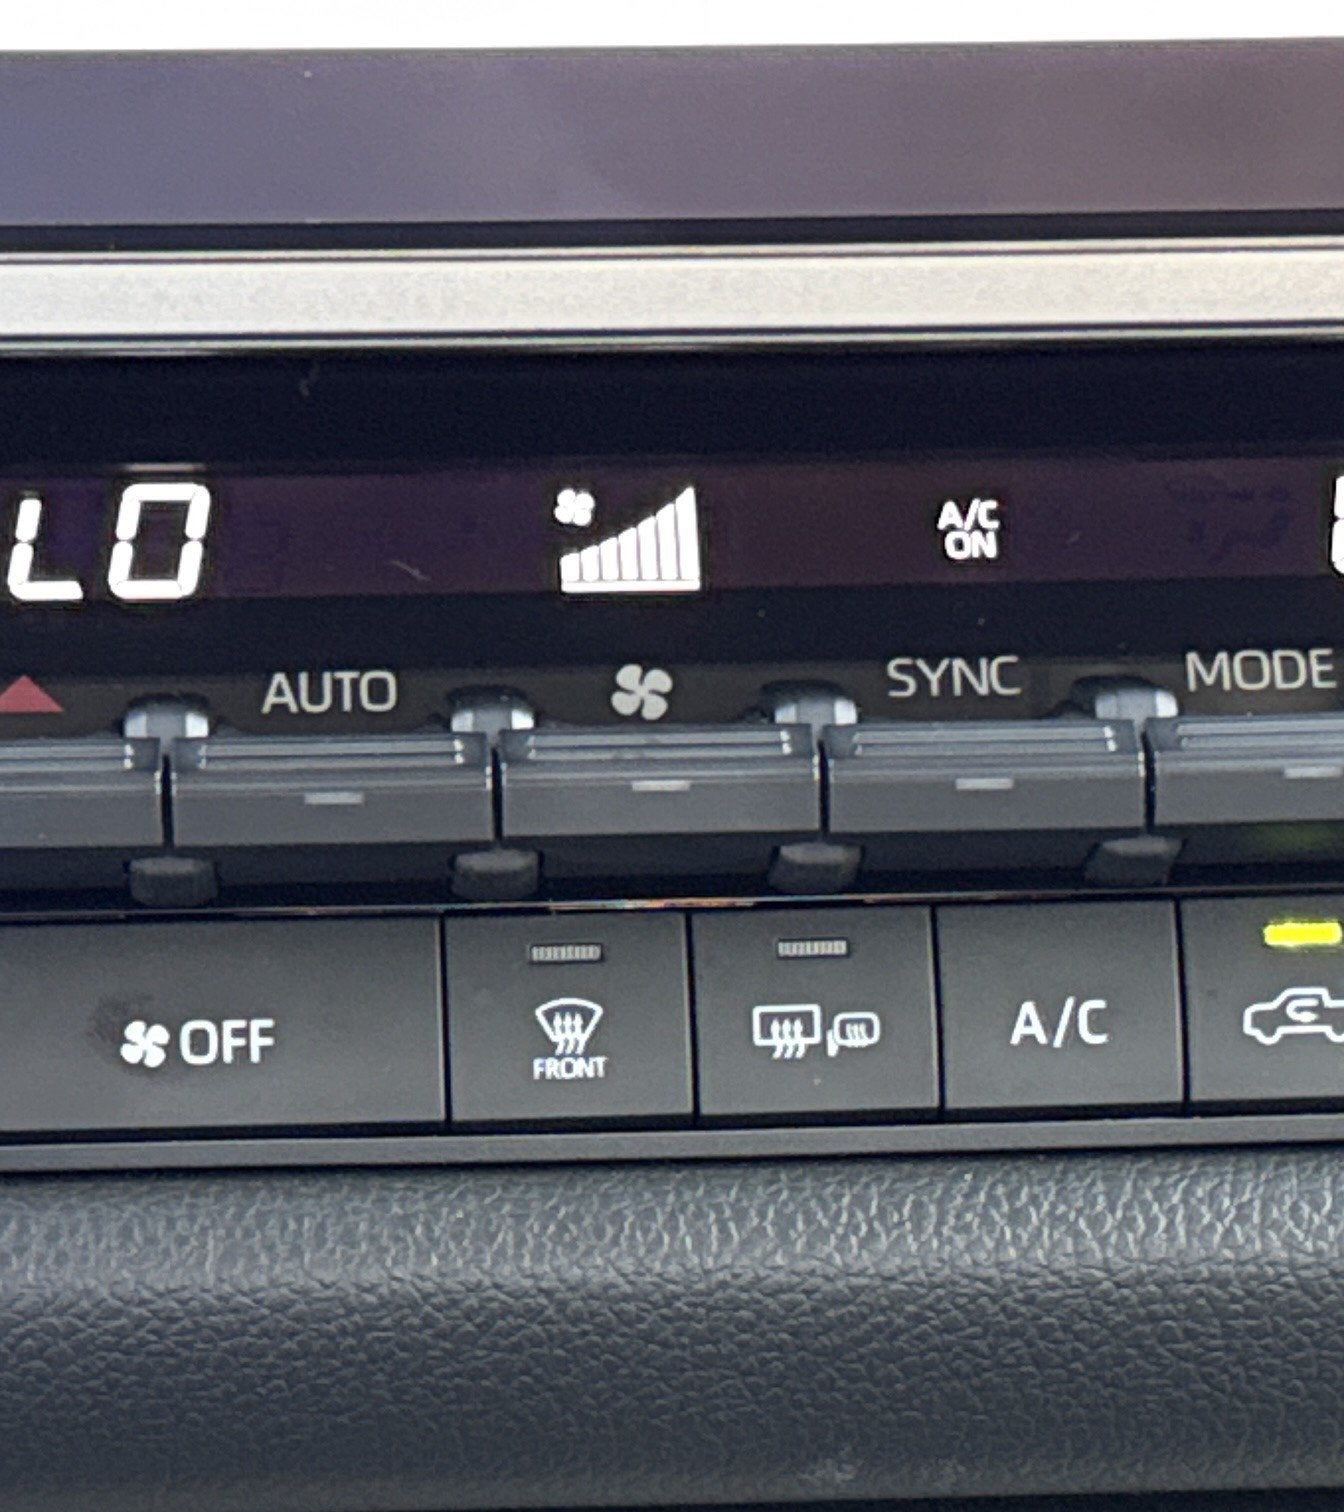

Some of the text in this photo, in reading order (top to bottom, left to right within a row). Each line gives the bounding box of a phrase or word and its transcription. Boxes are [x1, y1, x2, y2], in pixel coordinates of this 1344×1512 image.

[937, 497, 1000, 531] A/C
[943, 530, 998, 560] ON
[886, 655, 1023, 698] SYNC
[1185, 647, 1338, 693] MODE
[261, 670, 398, 714] AUTO
[179, 1017, 276, 1066] OFF
[1009, 996, 1109, 1049] A/C
[532, 1056, 607, 1081] FRONT
